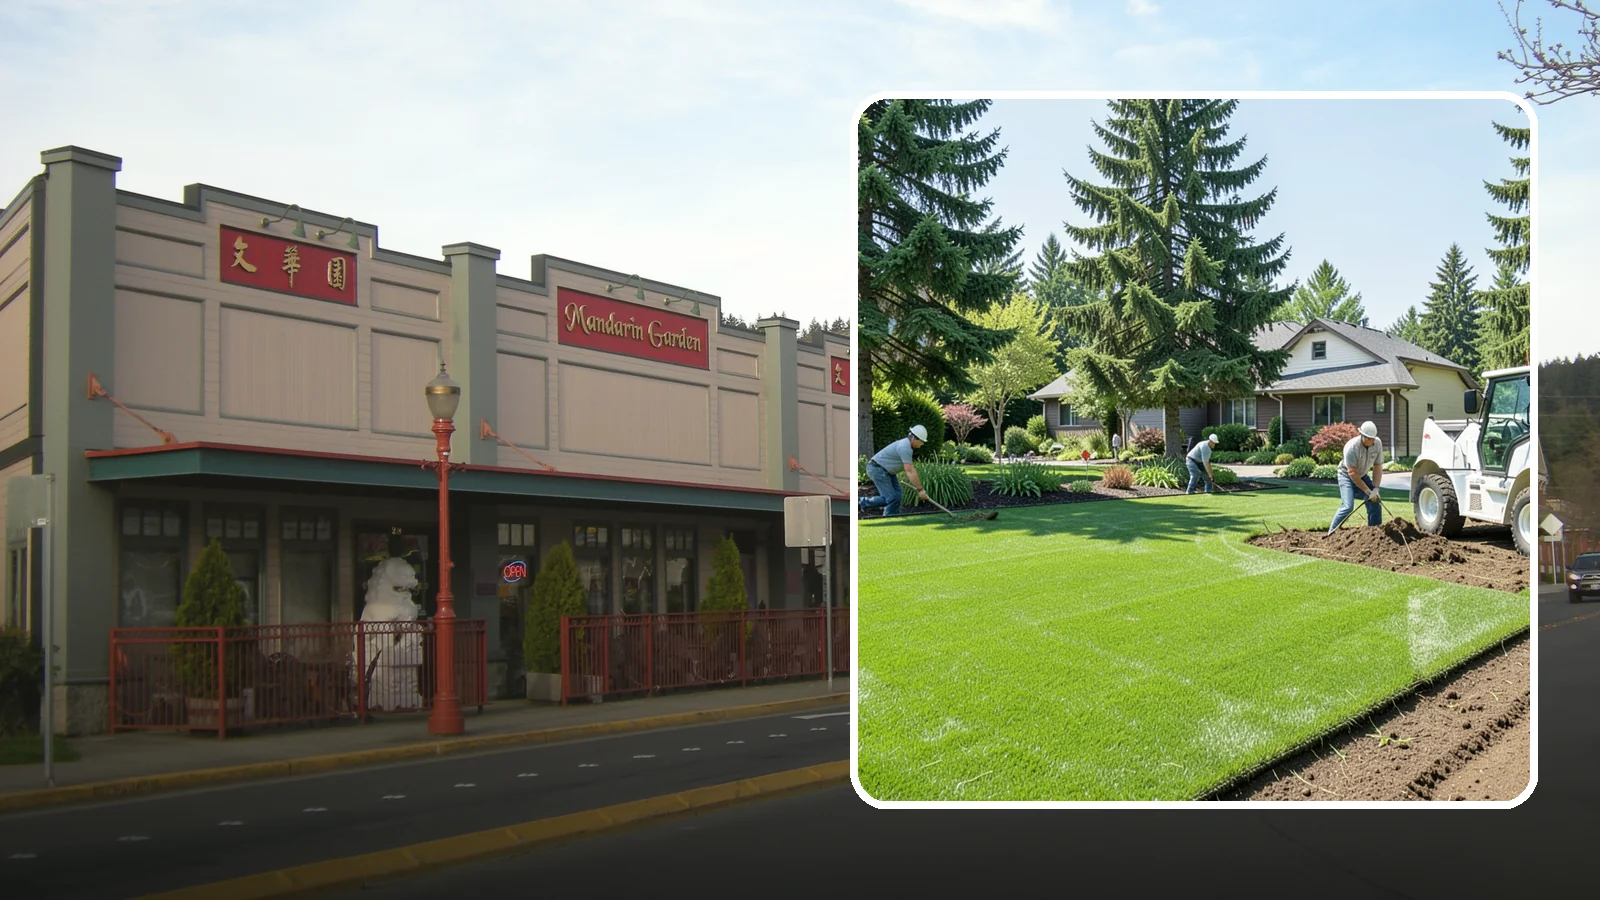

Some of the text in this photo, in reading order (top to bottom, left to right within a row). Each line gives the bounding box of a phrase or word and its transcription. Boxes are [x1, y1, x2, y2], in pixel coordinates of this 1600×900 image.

[231, 236, 346, 291] 文華園
[564, 302, 702, 352] Mandarin Garden
[503, 565, 527, 578] OPEN
